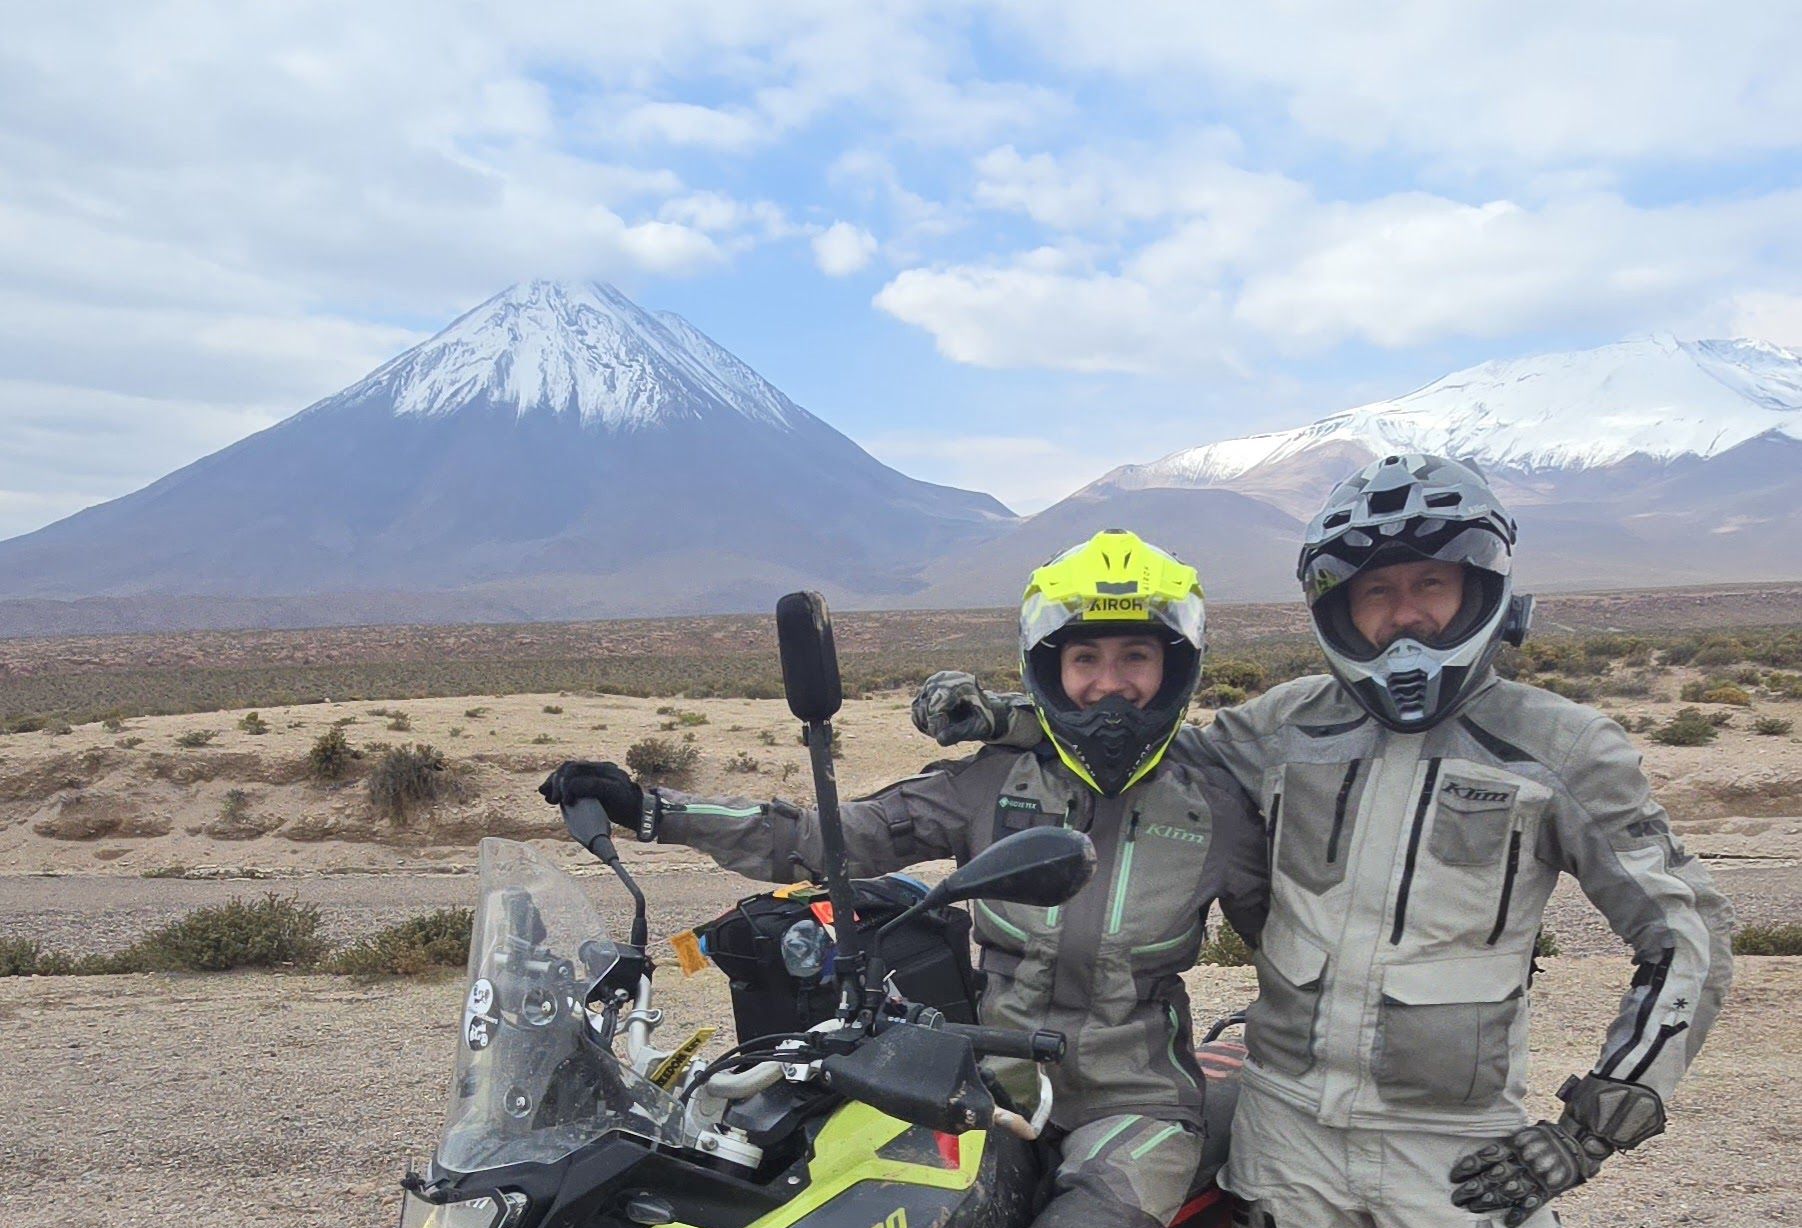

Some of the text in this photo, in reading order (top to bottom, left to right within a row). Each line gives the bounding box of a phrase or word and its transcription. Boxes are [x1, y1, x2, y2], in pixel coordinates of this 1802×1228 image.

[1089, 598, 1143, 611] AIROH
[1441, 781, 1509, 802] Klim
[1146, 823, 1205, 844] Klim
